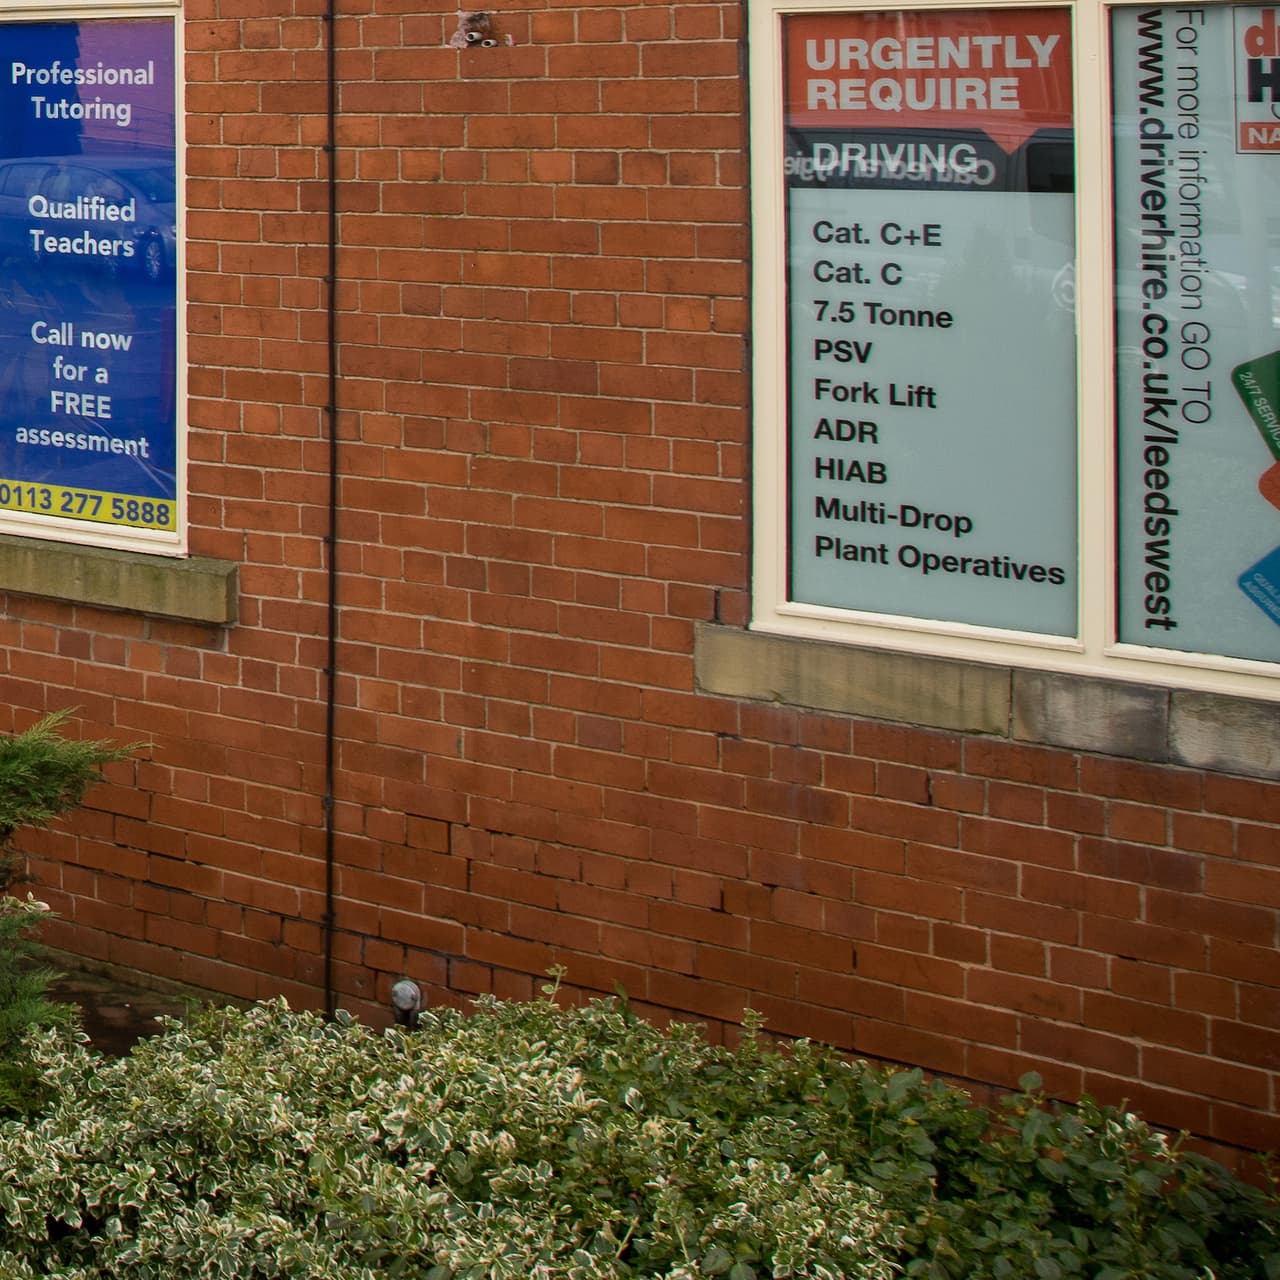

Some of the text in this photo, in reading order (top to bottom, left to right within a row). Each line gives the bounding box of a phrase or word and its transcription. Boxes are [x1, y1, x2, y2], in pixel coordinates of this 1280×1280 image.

[1244, 8, 1280, 58] d
[805, 34, 1061, 70] URGENTLY
[11, 60, 154, 85] Professional
[806, 76, 1020, 112] REQUIRE
[31, 96, 131, 127] Tutoring
[811, 142, 978, 174] DRIVING
[28, 195, 136, 222] Qualified
[1176, 9, 1212, 424] For more information GO TO
[29, 229, 135, 257] Teachers
[812, 220, 942, 247] Cat. C+E
[813, 260, 903, 286] Cat. C
[813, 299, 954, 329] 7.5 Tonne
[1137, 9, 1179, 631] www.driverhire.co.uk/leedswest
[31, 321, 132, 351] Call now
[814, 339, 873, 364] PSV
[52, 355, 109, 384] for a
[1239, 371, 1262, 395] 24/7
[50, 390, 112, 419] FREE
[814, 378, 937, 408] Fork Lift
[15, 426, 150, 458] assessment
[813, 418, 878, 444] ADR
[815, 456, 888, 484] HIAB
[60, 491, 103, 516] 277
[111, 497, 170, 526] 5888
[815, 496, 973, 538] Multi-Drop
[815, 535, 1066, 586] Plant Operatives
